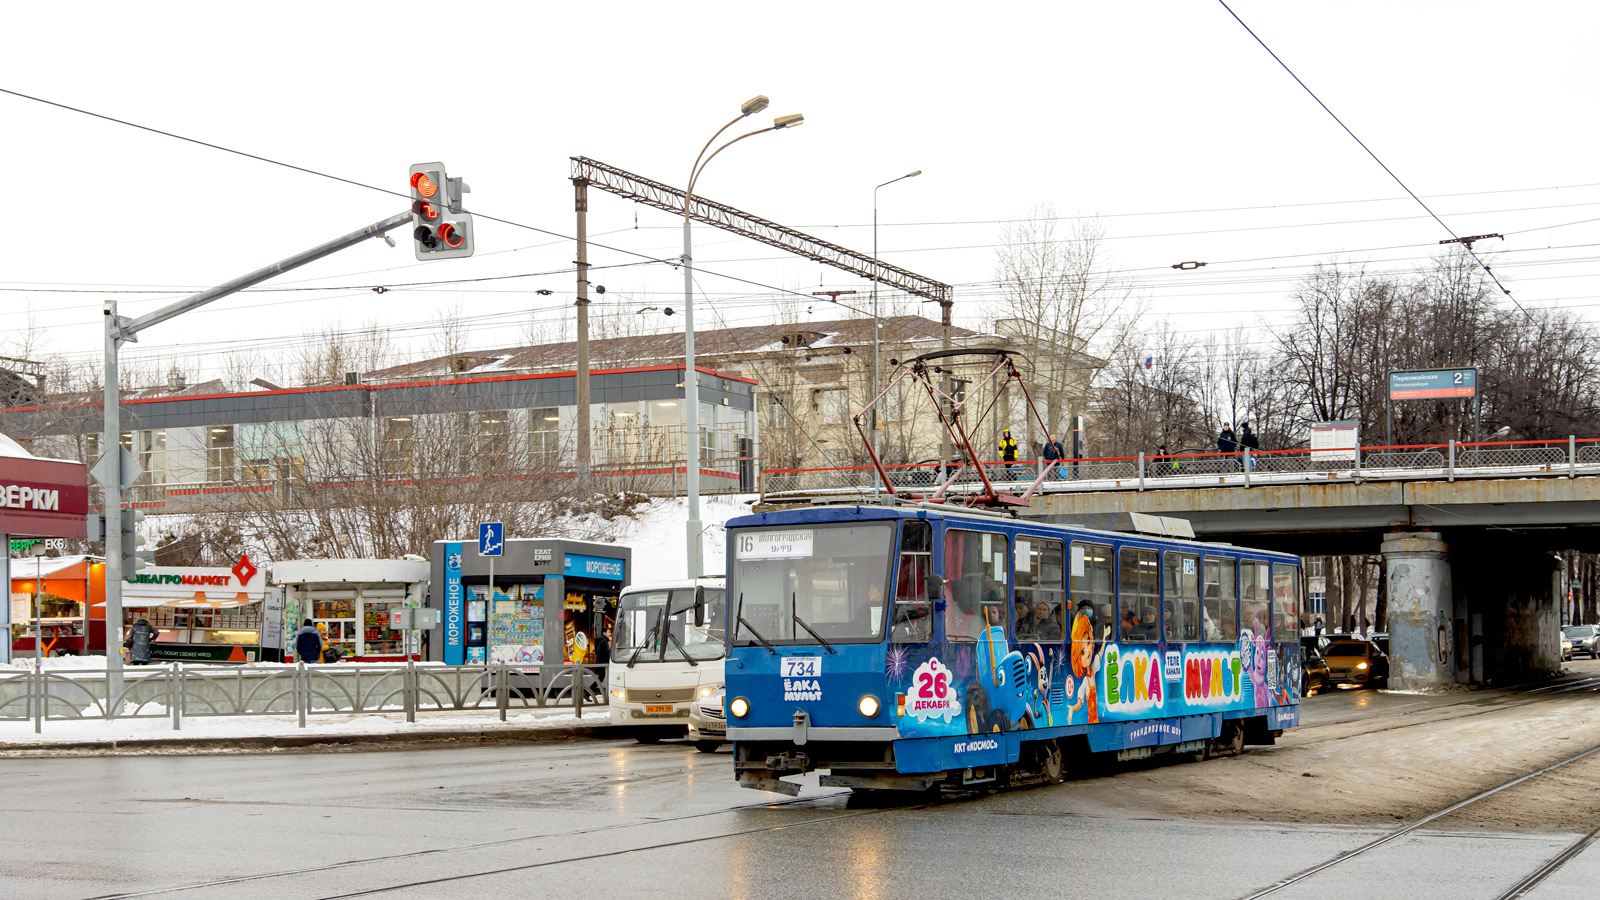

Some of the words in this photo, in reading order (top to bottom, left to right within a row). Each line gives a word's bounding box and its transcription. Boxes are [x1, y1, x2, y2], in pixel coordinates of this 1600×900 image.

[1393, 374, 1438, 382] Первомайская
[1453, 372, 1463, 384] 2
[740, 535, 754, 553] 16
[585, 560, 621, 576] МОРОЖЕНОЕ
[1184, 559, 1194, 573] 734
[448, 577, 460, 646] МОРОЖЕНОЕ
[930, 660, 937, 671] С
[1166, 655, 1180, 666] ТЕЛЕ
[787, 661, 815, 676] 734
[1166, 667, 1181, 676] КАНАЛА
[783, 678, 821, 691] ЁЛКА
[1106, 650, 1162, 705] ЁЛКА
[1185, 657, 1241, 700] МУЛЬТ
[918, 672, 947, 699] 26
[784, 691, 822, 701] МУЛЬТ
[914, 700, 950, 711] ДЕКАБРЯ
[1130, 724, 1170, 741] ГРАНДИОЗНОЕ
[1171, 726, 1181, 736] ШОУ
[954, 742, 966, 753] ККТ
[967, 739, 998, 752] «КОСМОС»
